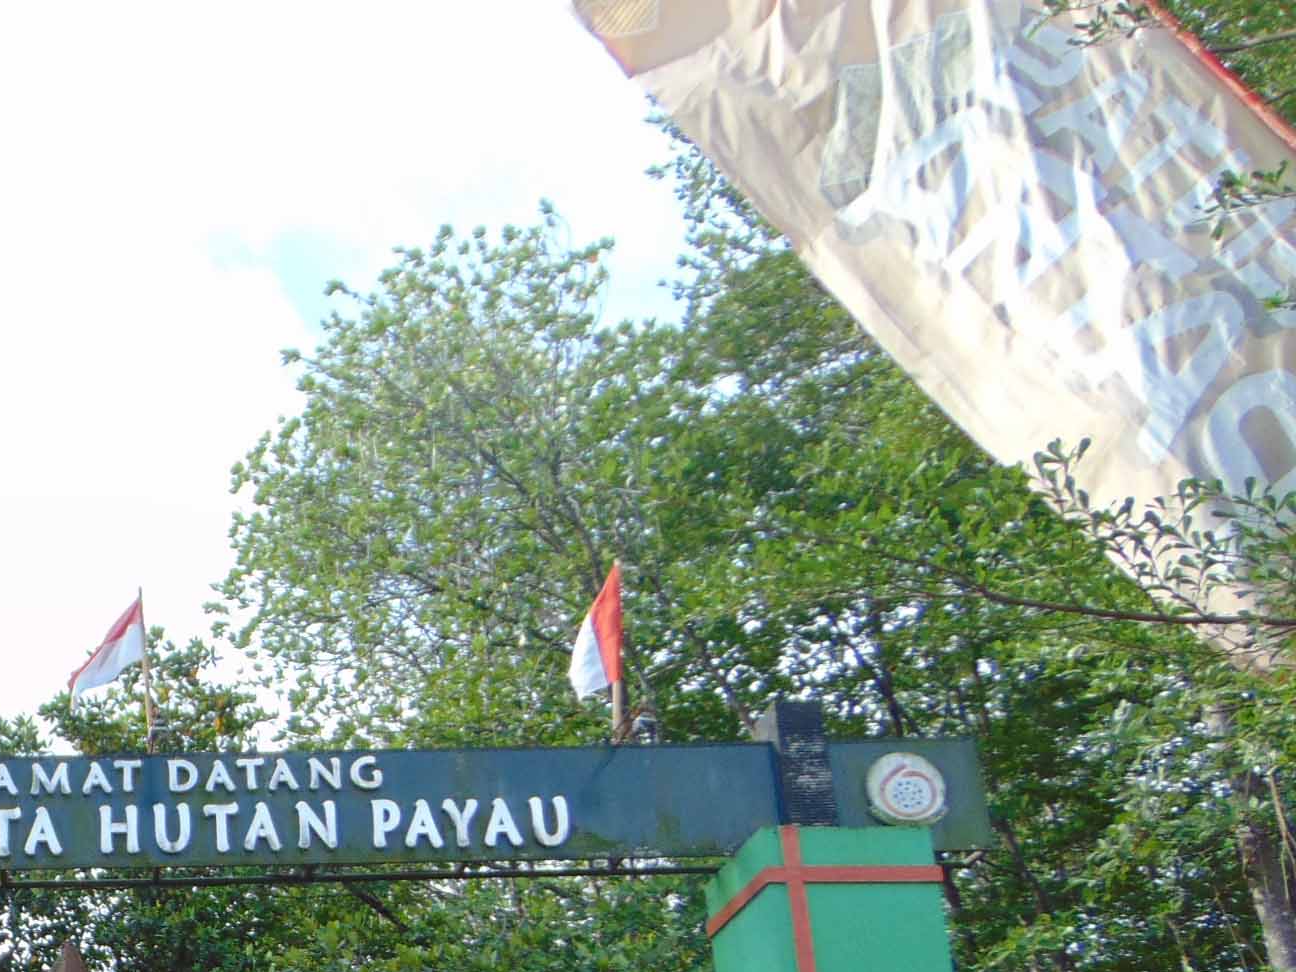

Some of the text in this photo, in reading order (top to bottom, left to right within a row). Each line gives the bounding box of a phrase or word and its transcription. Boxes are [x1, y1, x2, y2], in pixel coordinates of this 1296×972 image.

[166, 755, 384, 793] DATANG
[99, 800, 339, 853] HUTAN
[370, 795, 570, 849] PAYAU
